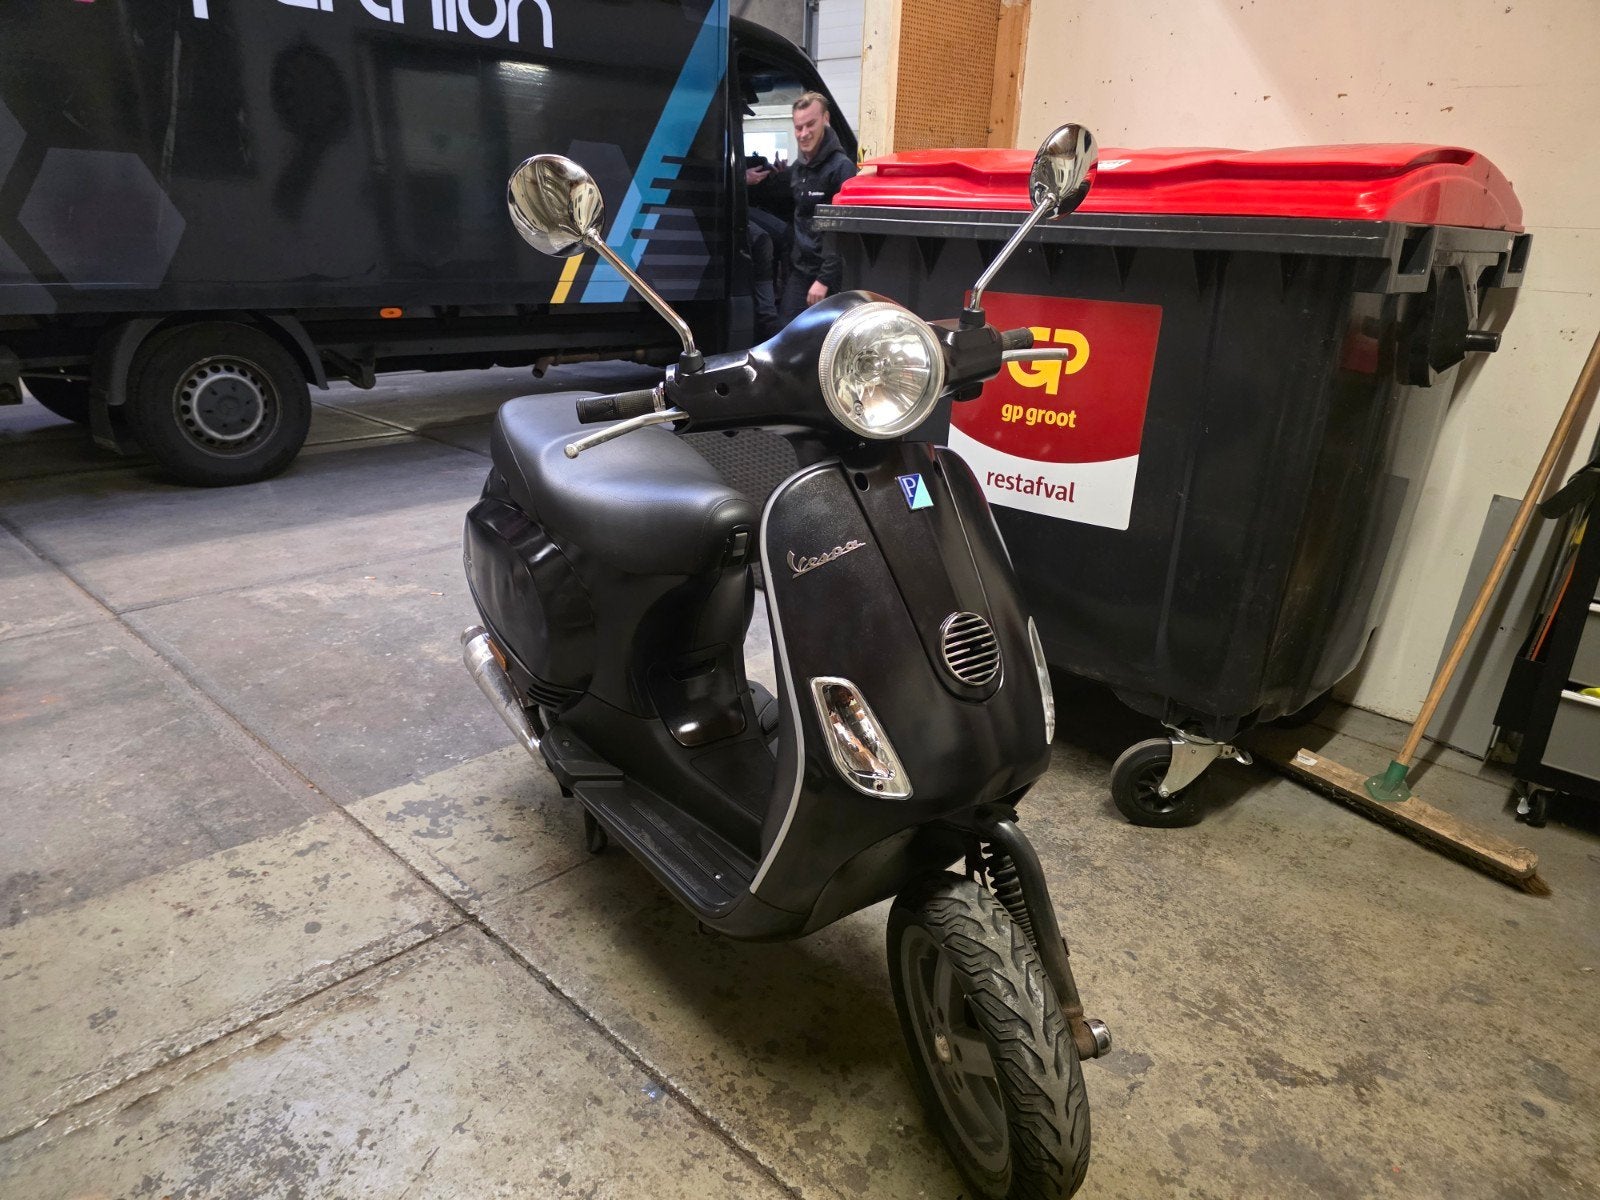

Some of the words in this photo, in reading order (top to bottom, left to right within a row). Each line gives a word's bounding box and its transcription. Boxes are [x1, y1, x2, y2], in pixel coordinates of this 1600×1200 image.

[1007, 326, 1090, 395] GP
[1001, 403, 1024, 423] gp
[1025, 407, 1077, 428] groot
[902, 477, 917, 498] P
[986, 471, 1075, 503] restafval
[786, 539, 867, 578] Vespa
